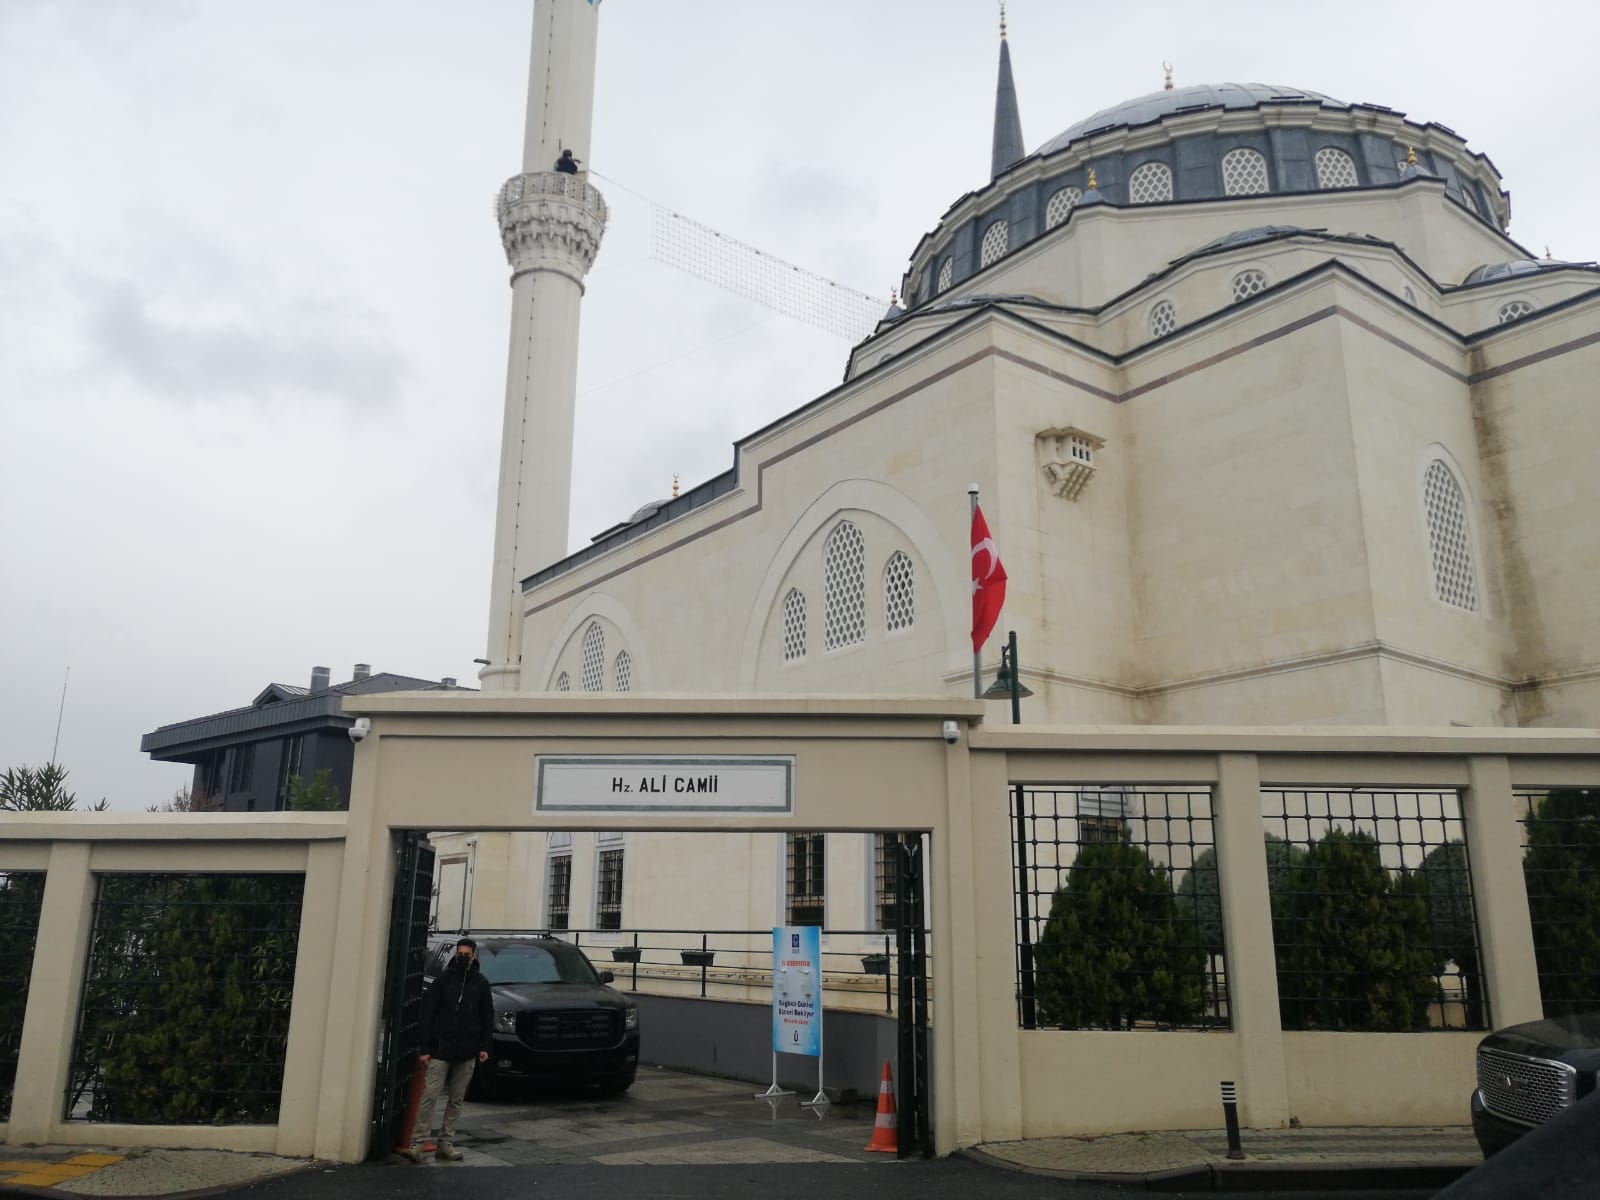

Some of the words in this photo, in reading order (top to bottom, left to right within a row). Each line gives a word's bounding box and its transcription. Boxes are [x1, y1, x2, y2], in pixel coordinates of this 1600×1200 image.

[613, 777, 634, 792] Hz.
[639, 774, 667, 793] ALİ
[674, 774, 718, 793] CAMİİ
